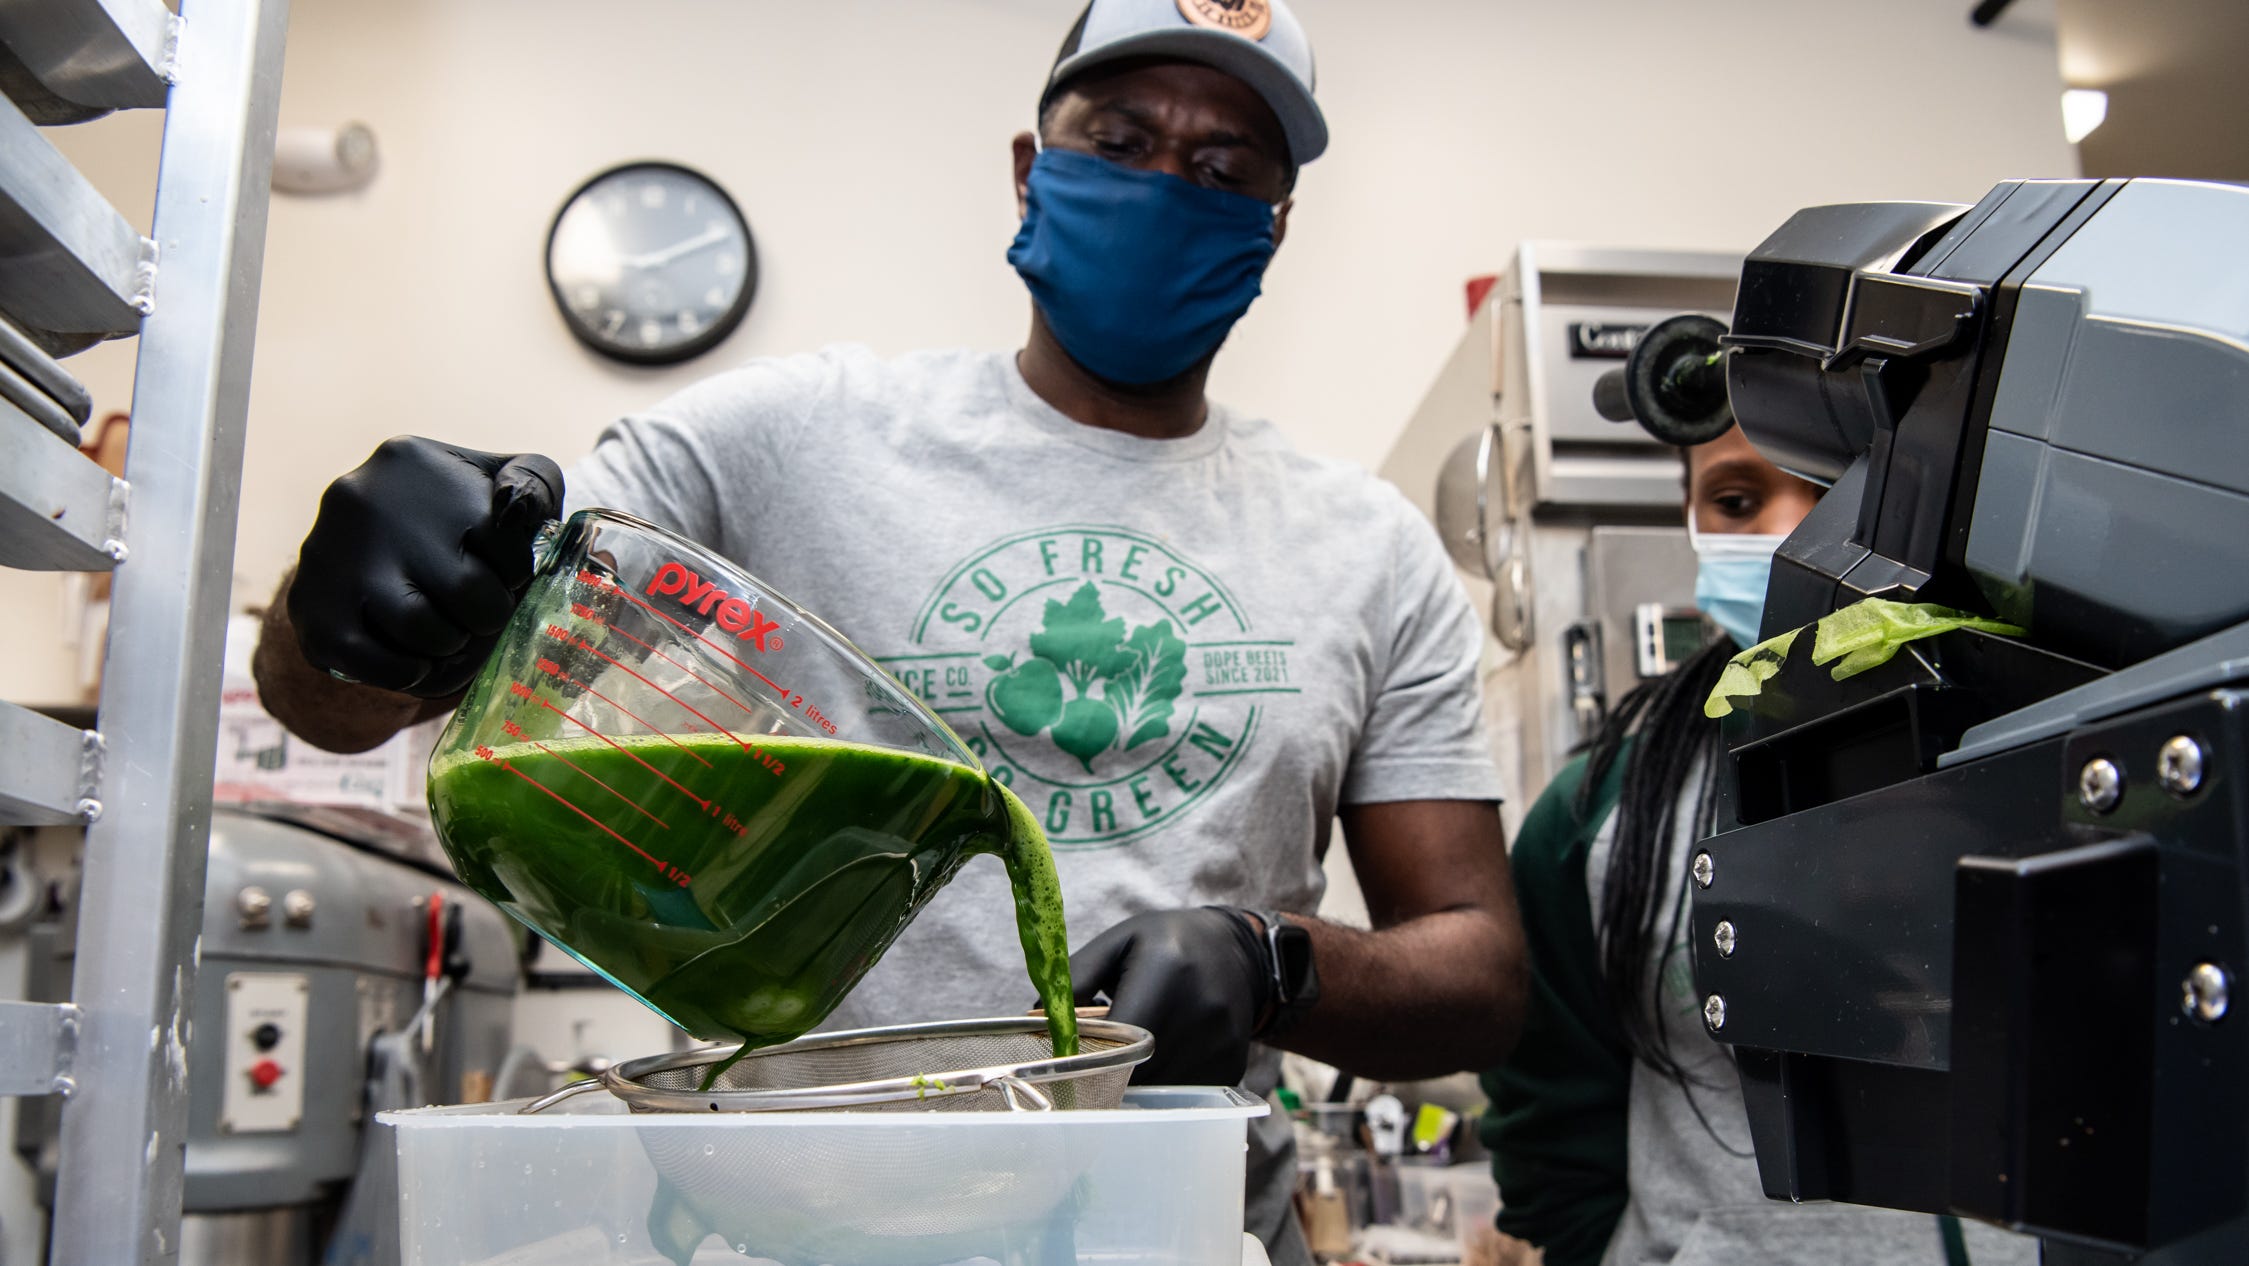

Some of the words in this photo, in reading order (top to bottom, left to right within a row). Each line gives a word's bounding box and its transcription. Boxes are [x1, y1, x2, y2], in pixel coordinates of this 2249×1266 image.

[940, 566, 1008, 634] SO
[1039, 537, 1223, 627] FRESH
[545, 624, 570, 641] 1500
[1203, 651, 1240, 669] DOPE
[1206, 666, 1248, 685] SINCE
[1253, 666, 1290, 683] 2021
[790, 695, 804, 709] 2
[804, 704, 837, 735] litres
[501, 719, 522, 737] 750
[475, 744, 494, 761] 500
[1046, 721, 1233, 834] GREEN
[712, 806, 722, 818] 1
[722, 812, 749, 839] litre
[667, 866, 692, 888] 1/2
